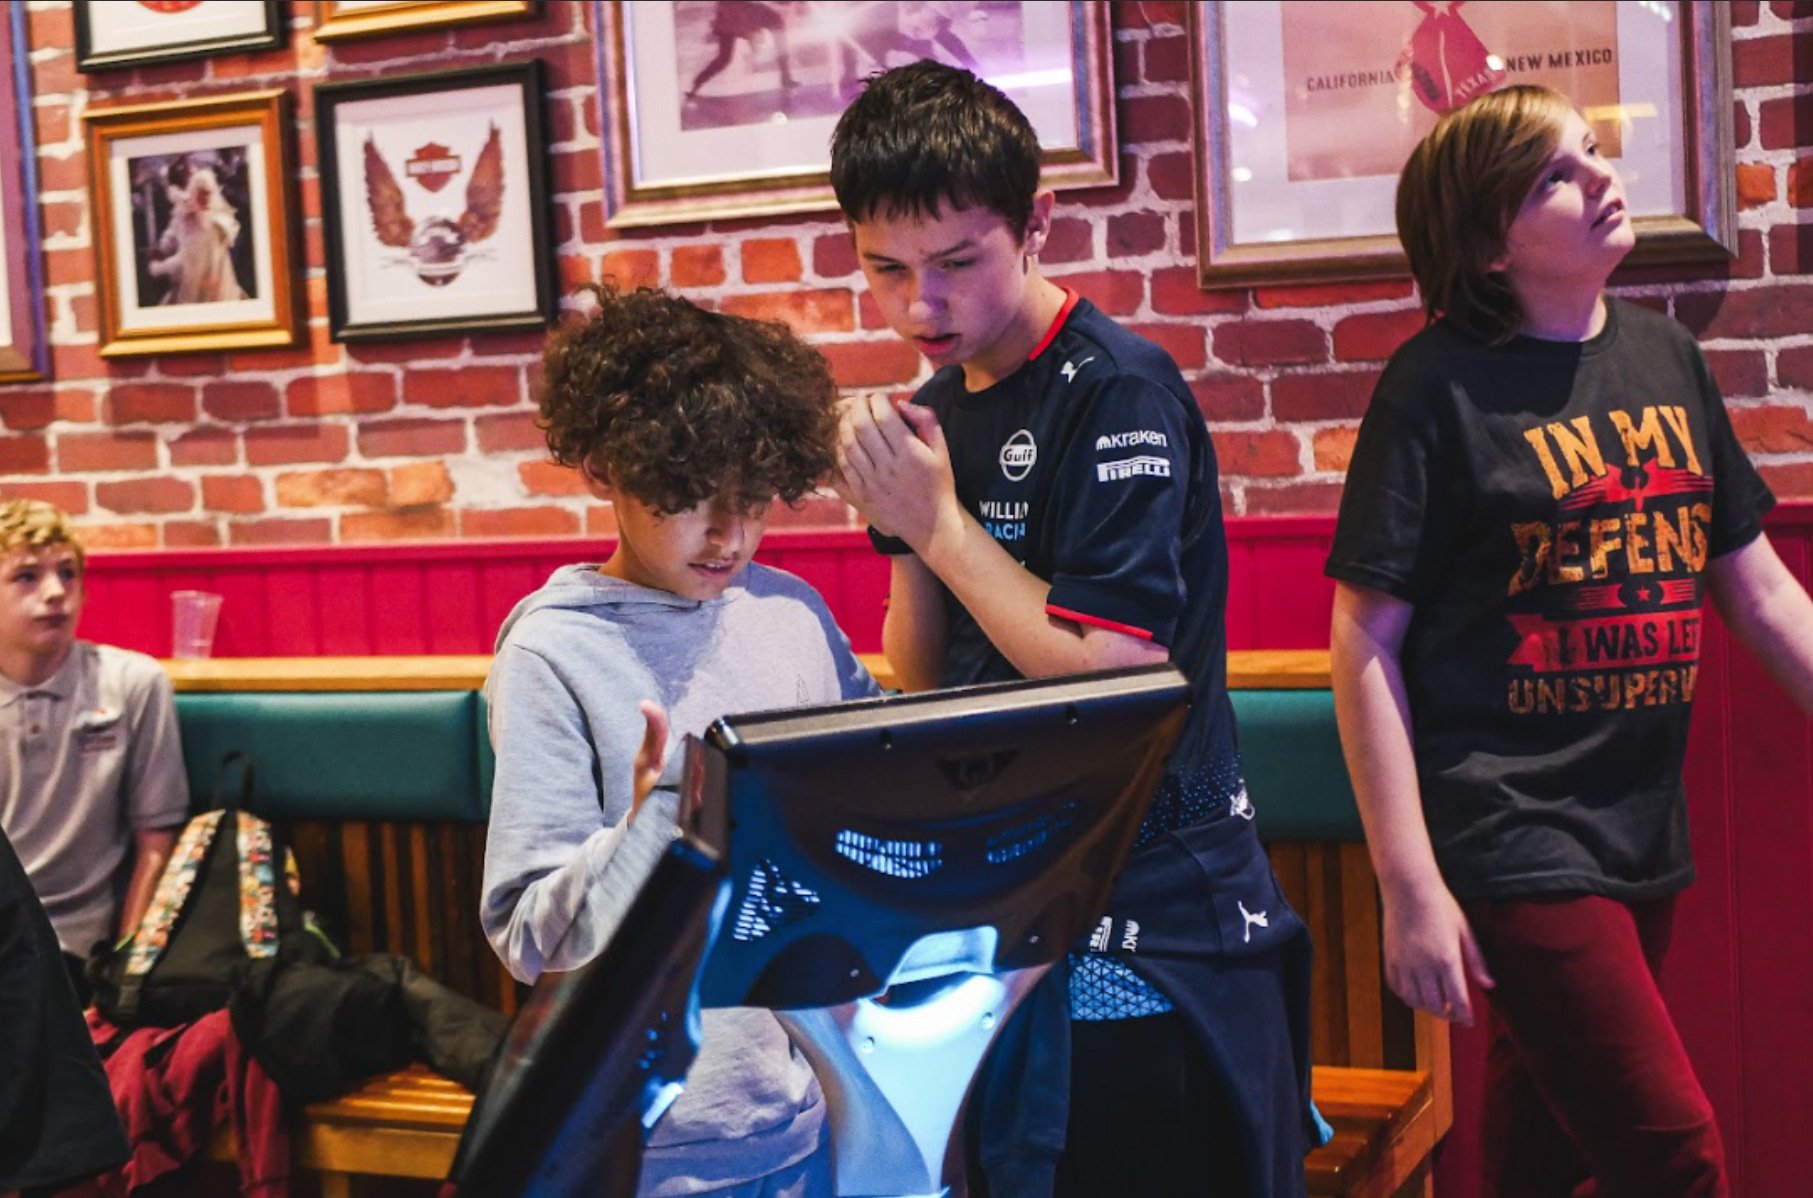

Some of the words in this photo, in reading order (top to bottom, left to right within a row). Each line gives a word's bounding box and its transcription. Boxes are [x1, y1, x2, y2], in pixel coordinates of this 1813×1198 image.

[1506, 54, 1542, 71] NEW
[1548, 49, 1612, 68] MEXICO
[1306, 70, 1395, 92] CALIFORNIA
[1003, 448, 1034, 462] Gulf
[1523, 414, 1608, 500] IN
[1608, 405, 1703, 476] MY
[1096, 456, 1170, 482] PIRELLI
[1583, 622, 1659, 662] WAS
[1667, 617, 1699, 655] LE
